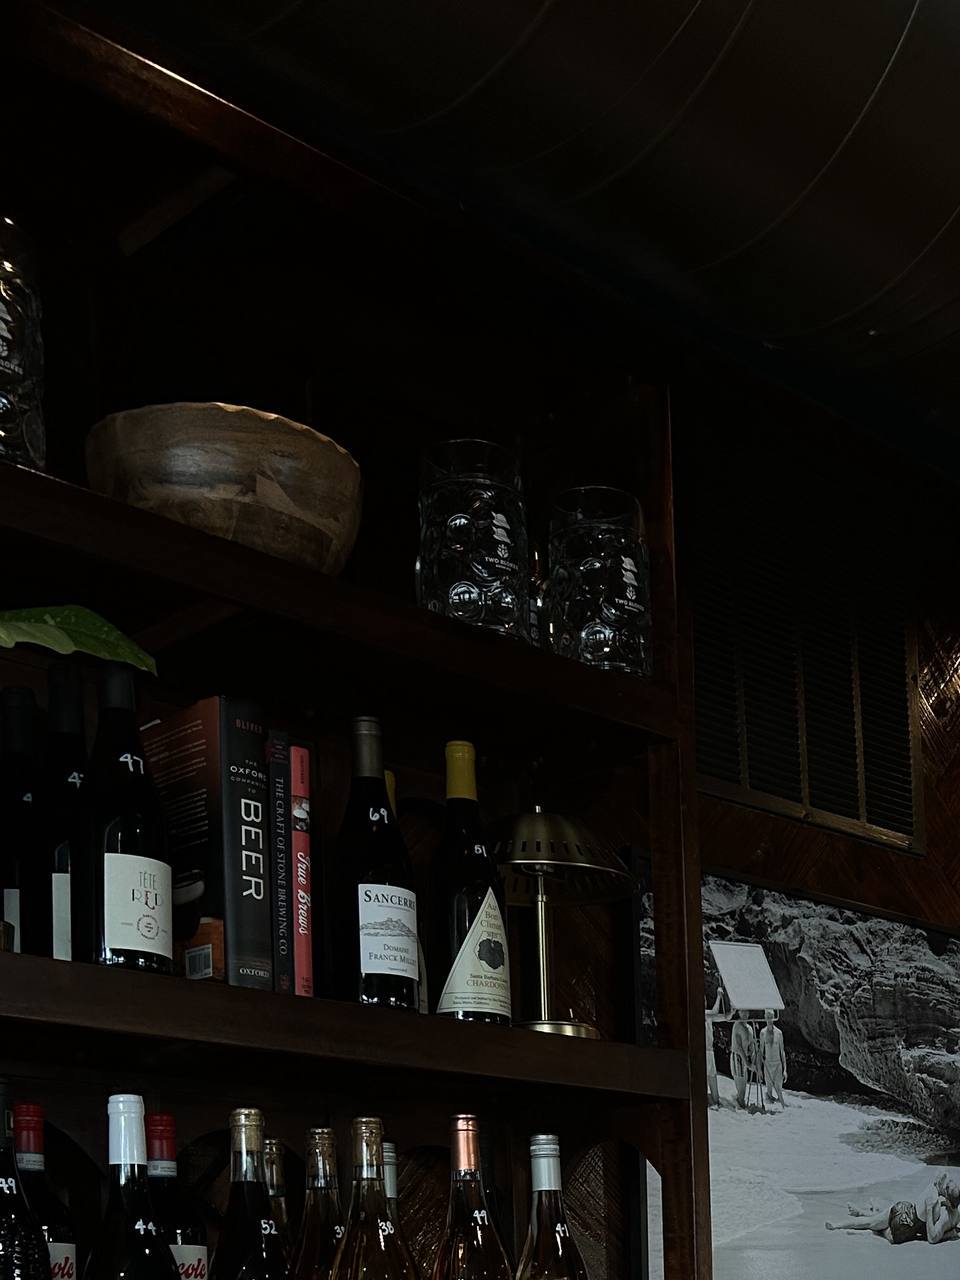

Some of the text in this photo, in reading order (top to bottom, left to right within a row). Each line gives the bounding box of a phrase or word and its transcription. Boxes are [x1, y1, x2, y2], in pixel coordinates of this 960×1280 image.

[119, 753, 144, 775] 47
[275, 777, 285, 799] THE
[276, 801, 286, 834] CRAFT
[369, 807, 389, 824] 69
[240, 798, 264, 900] BEER
[276, 836, 286, 850] OF
[277, 853, 287, 887] STONE
[297, 851, 311, 936] True Brews
[364, 889, 416, 912] SANCERRE
[277, 887, 288, 937] BREWING
[368, 952, 398, 962] FRANCK
[240, 967, 269, 977] OXFORD
[261, 1219, 279, 1235] 52
